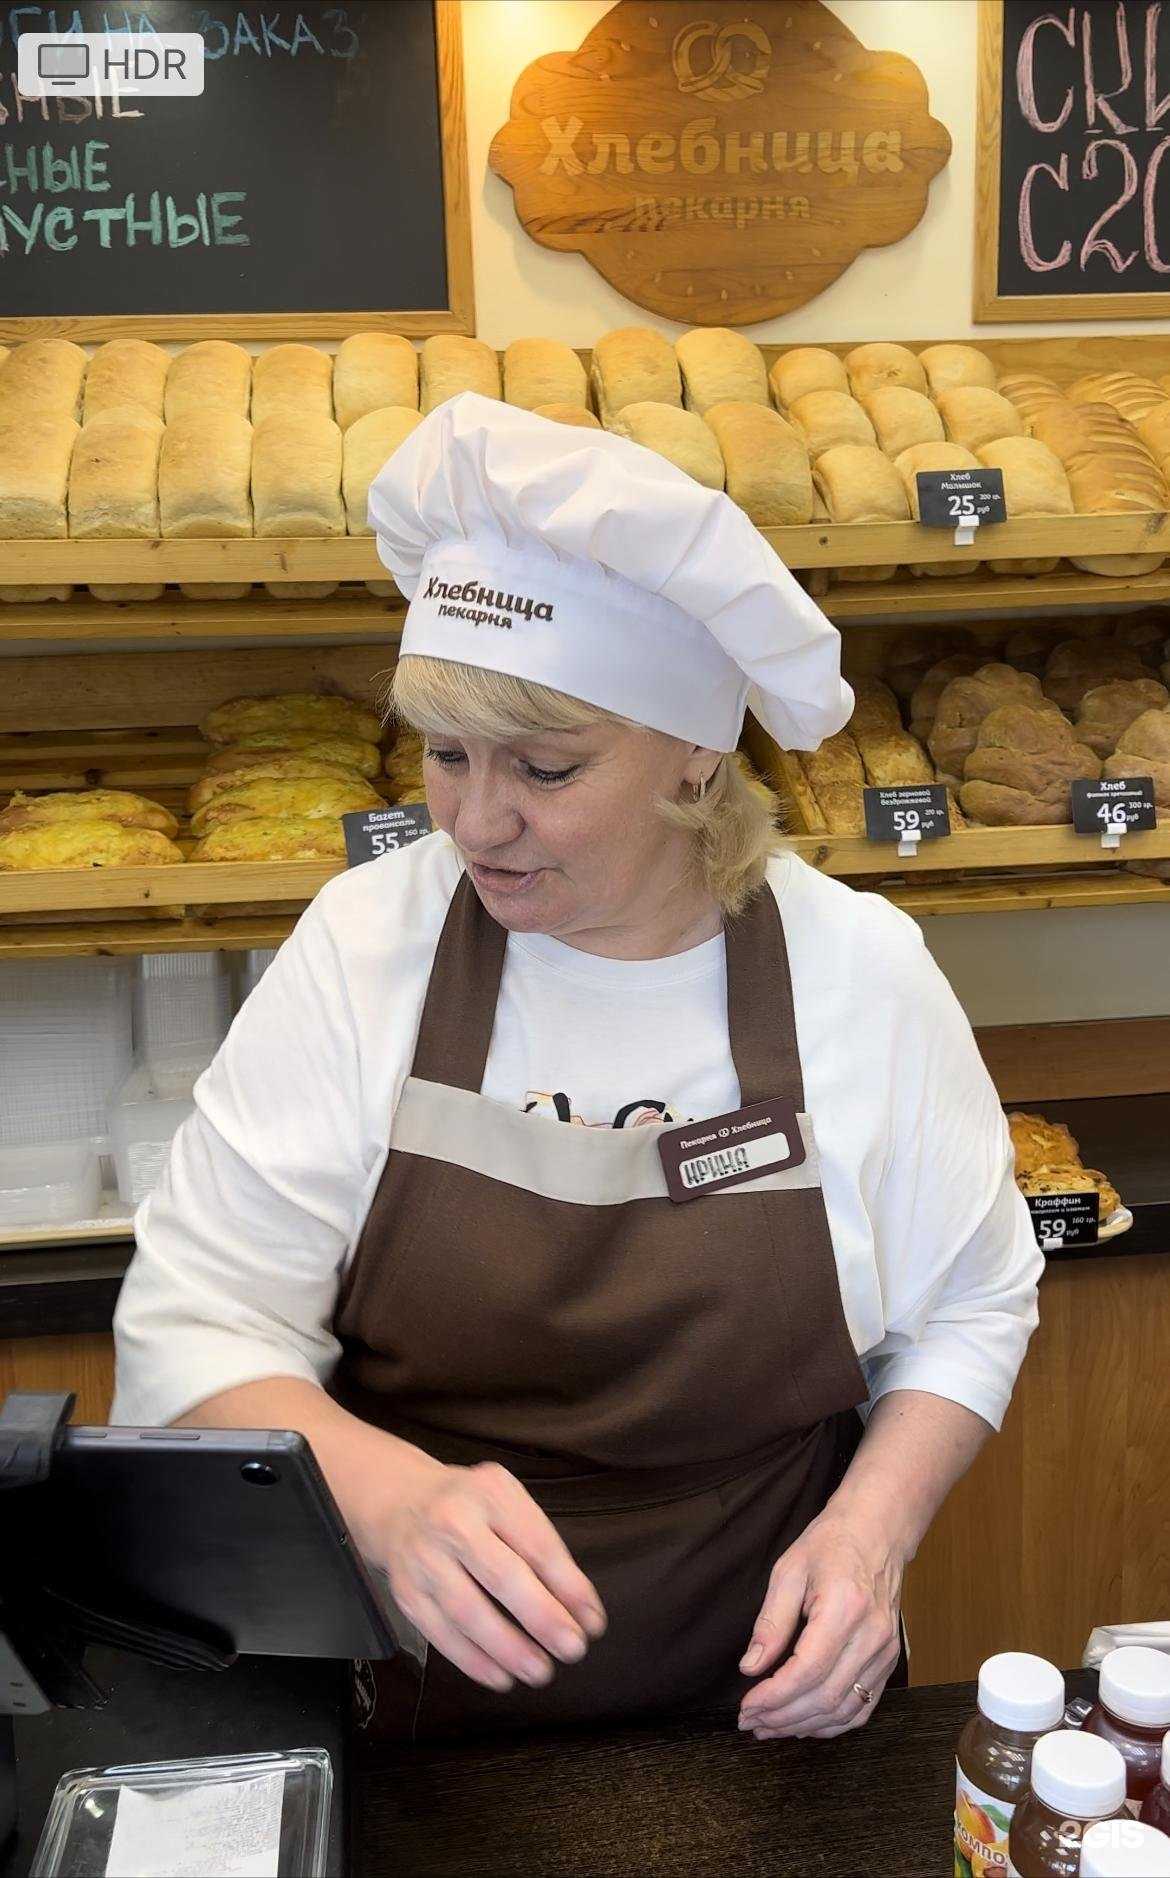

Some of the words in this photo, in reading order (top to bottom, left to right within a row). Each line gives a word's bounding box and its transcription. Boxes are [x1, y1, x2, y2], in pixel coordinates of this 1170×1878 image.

[540, 116, 904, 184] Хлебница
[0, 139, 112, 194] НЫЕ
[634, 194, 811, 228] пекарня
[948, 495, 975, 516] 25
[423, 576, 554, 622] Хлебница
[438, 603, 513, 629] пекарня
[1100, 781, 1126, 792] Хлеб
[368, 811, 405, 823] Багет
[893, 810, 920, 831] 59
[1097, 803, 1127, 823] 46
[362, 819, 416, 832] провансаль
[371, 832, 400, 855] 55
[680, 1133, 718, 1150] Пекарня
[731, 1117, 773, 1135] Хлебница
[1035, 1197, 1081, 1208] Краффин
[1038, 1219, 1067, 1239] 59
